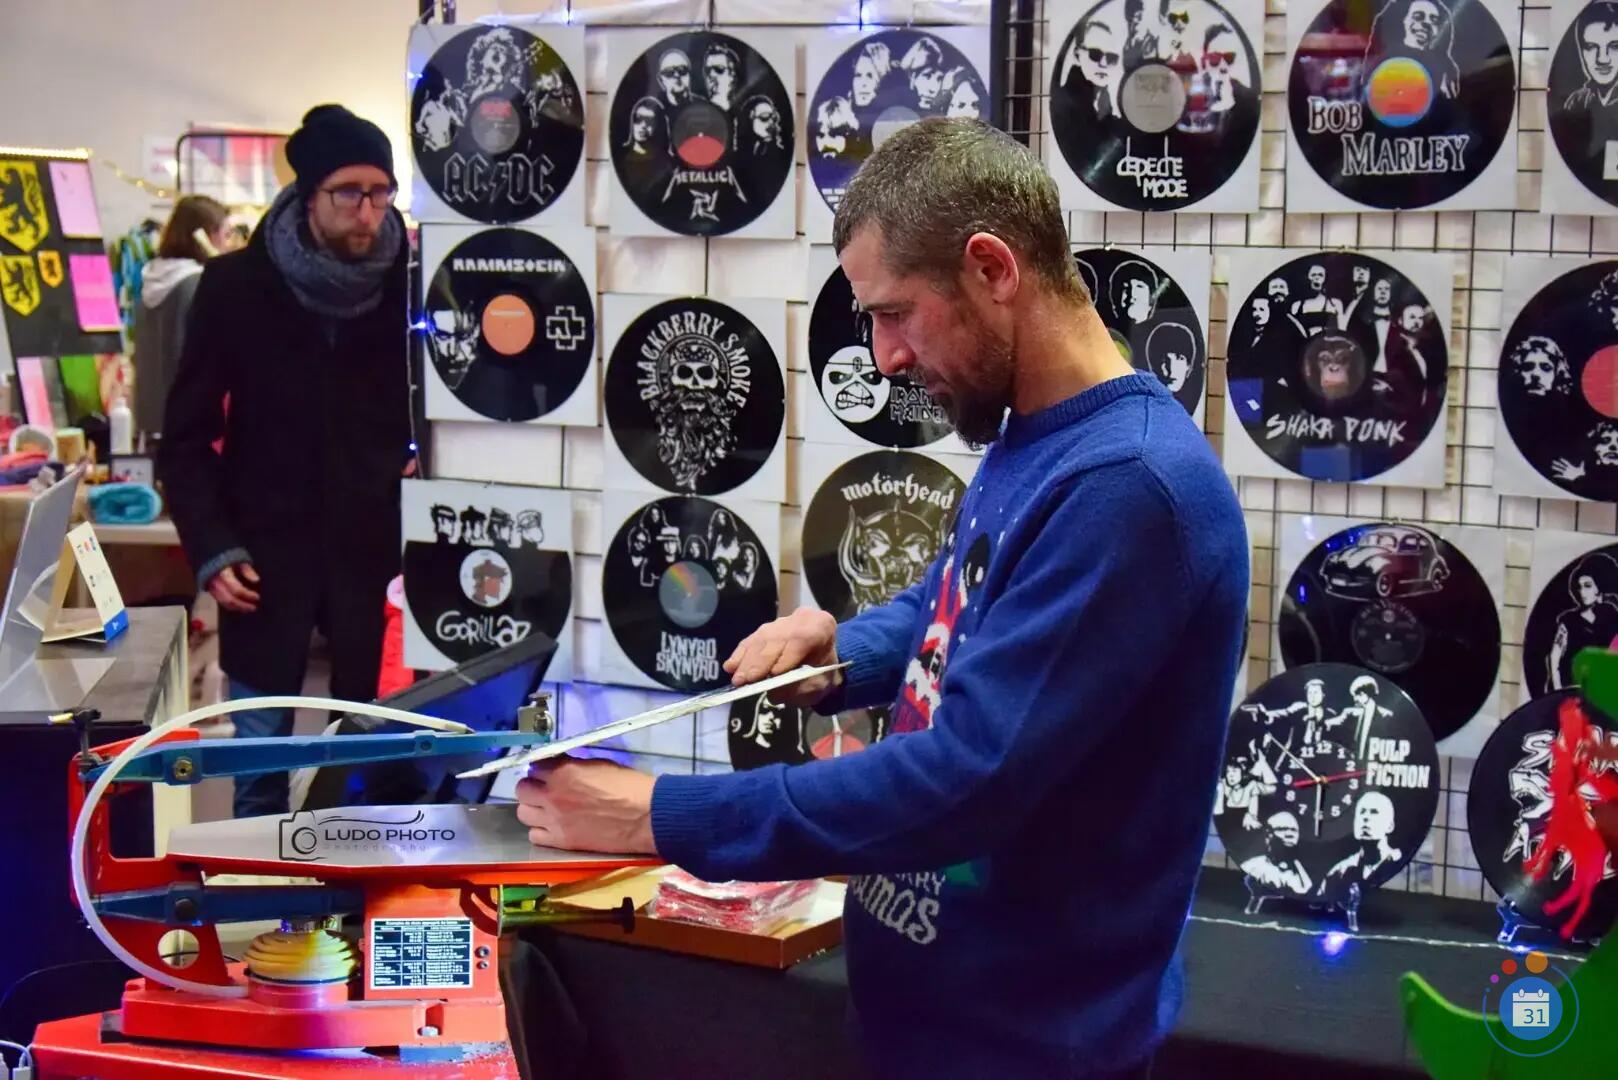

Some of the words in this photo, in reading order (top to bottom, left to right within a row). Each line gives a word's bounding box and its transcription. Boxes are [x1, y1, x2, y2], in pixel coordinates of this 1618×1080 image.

[1307, 96, 1363, 133] BOB
[1341, 132, 1470, 176] MARLEY
[662, 165, 747, 203] METALLICA
[1143, 177, 1189, 199] MODE
[453, 257, 567, 273] RAMMSTEIN
[637, 310, 725, 401] BLACKBERRY
[720, 332, 752, 408] SMOKE
[889, 404, 947, 426] MAIDE
[1266, 413, 1335, 440] SHAKA
[1343, 415, 1407, 448] PONK
[661, 631, 717, 660] LYNYRD
[730, 717, 742, 734] 9
[1301, 746, 1315, 758] 11
[1316, 740, 1332, 754] 12
[1337, 748, 1346, 760] 1
[1367, 737, 1411, 763] PULP
[1345, 760, 1356, 772] 2
[1283, 773, 1293, 785] 9
[1365, 761, 1431, 789] FICTION
[1349, 778, 1359, 790] 3
[1285, 790, 1296, 802] 8
[1342, 794, 1352, 805] 4
[1299, 804, 1308, 815] 7
[1331, 806, 1341, 817] 5
